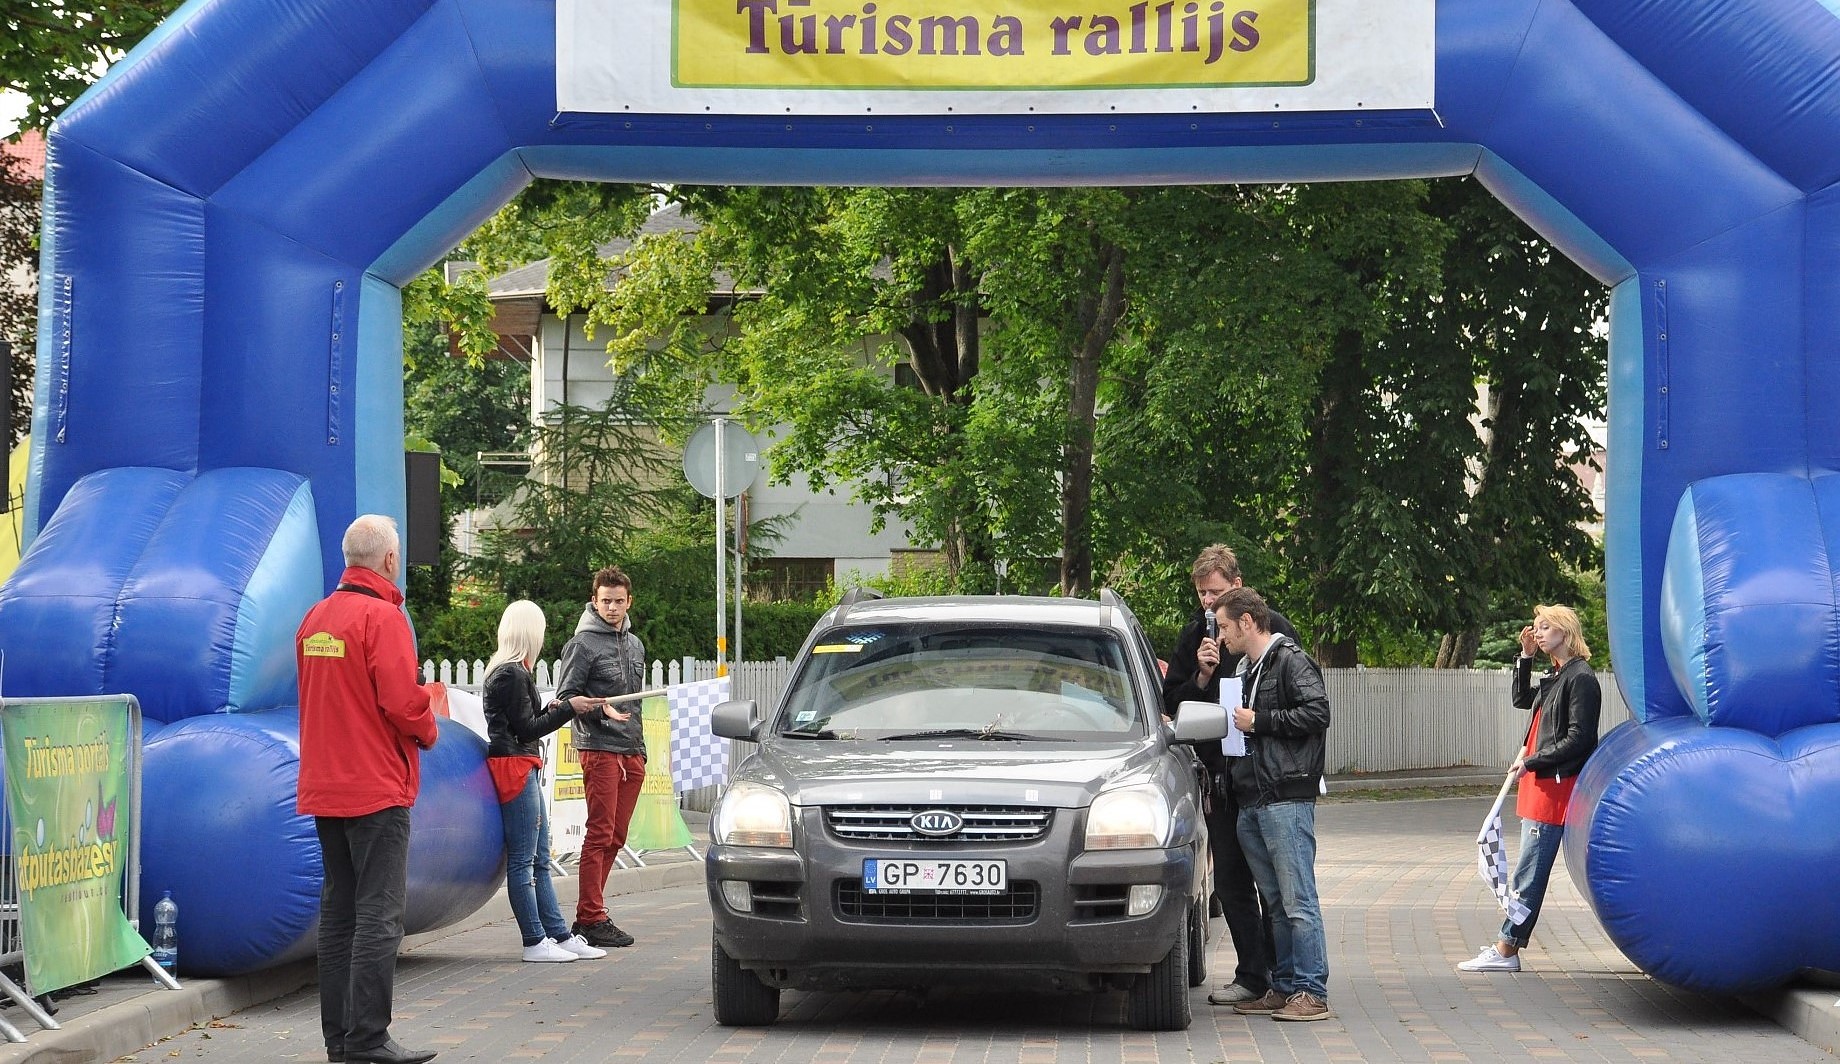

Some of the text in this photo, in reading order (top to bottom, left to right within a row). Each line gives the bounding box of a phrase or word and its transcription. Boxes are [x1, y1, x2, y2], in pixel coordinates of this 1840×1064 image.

[736, 0, 1261, 65] Tūrisma rallijs
[920, 815, 954, 829] KIA
[865, 876, 877, 884] LV
[883, 863, 1001, 886] GP 7630
